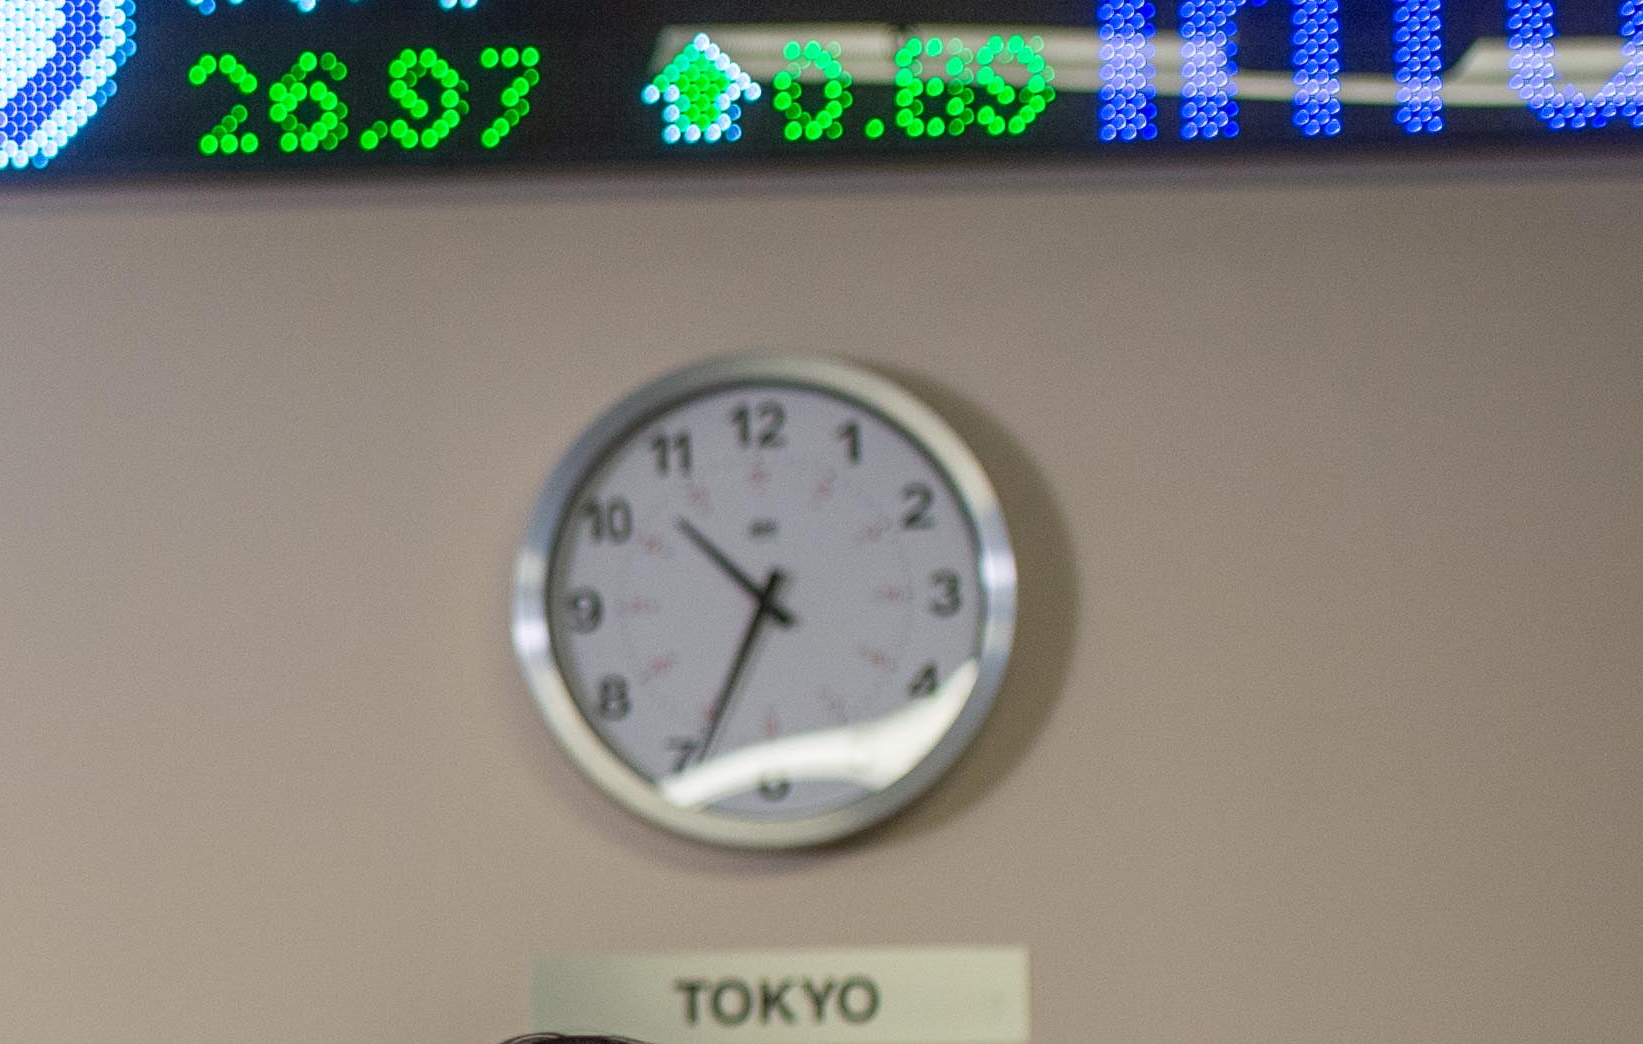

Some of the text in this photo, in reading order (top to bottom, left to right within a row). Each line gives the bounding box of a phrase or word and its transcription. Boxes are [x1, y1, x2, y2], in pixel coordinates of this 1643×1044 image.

[187, 45, 542, 156] 26.97
[730, 402, 787, 450] 12
[838, 419, 862, 466] 1
[651, 430, 694, 477] 11
[581, 496, 634, 545] 10
[901, 483, 934, 531] 2
[570, 586, 605, 634] 9
[929, 570, 962, 618] 3
[597, 674, 632, 722] 8
[674, 974, 882, 1027] TOKYO
